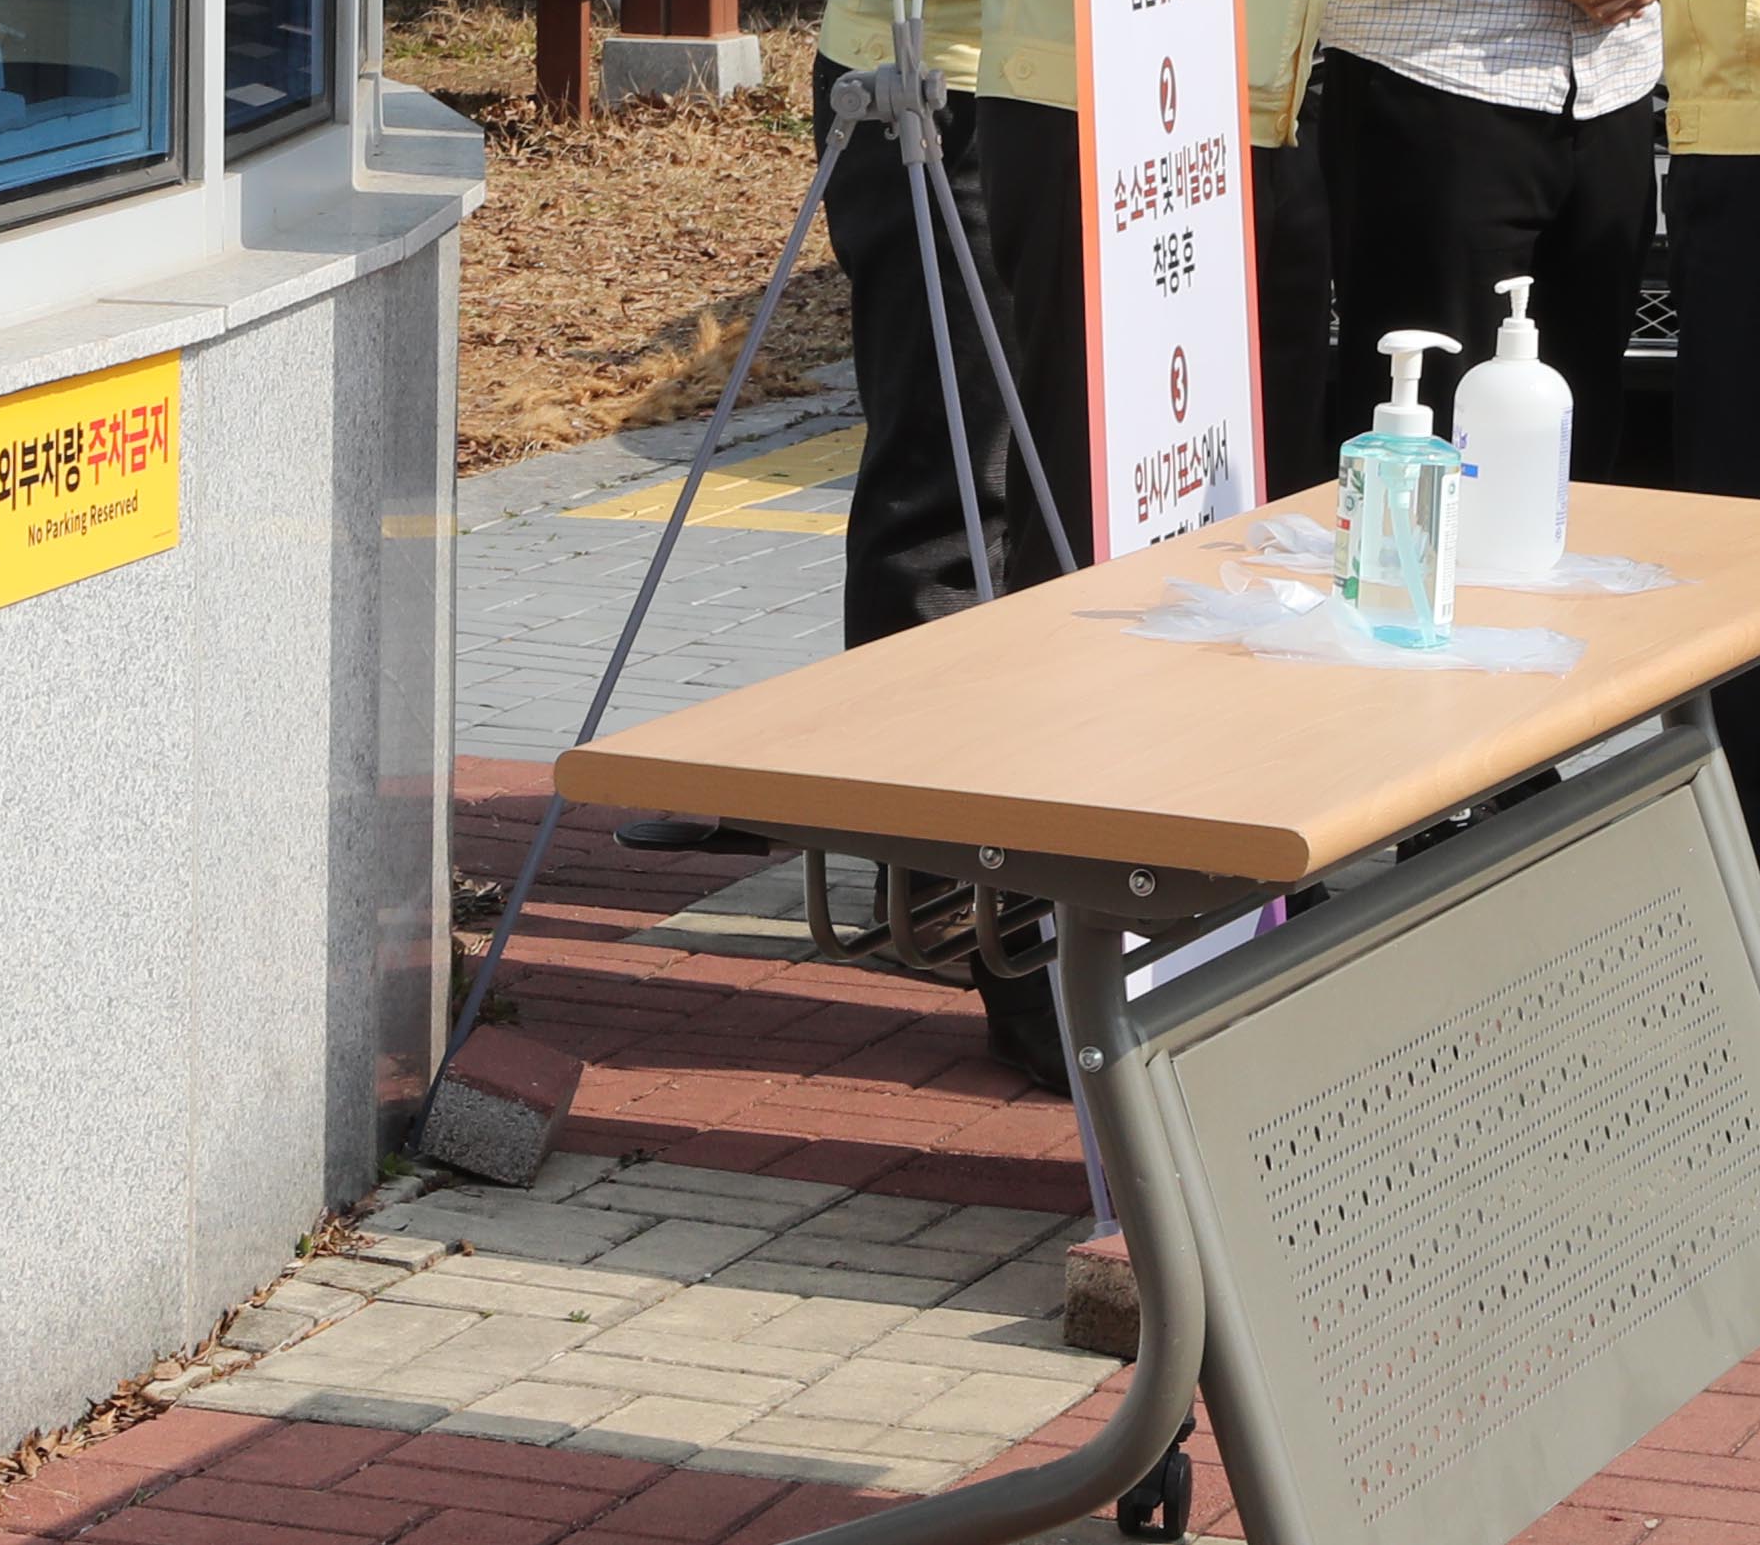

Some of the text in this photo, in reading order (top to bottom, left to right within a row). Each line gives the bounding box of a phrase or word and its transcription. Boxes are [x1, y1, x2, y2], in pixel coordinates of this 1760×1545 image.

[1175, 133, 1227, 209] 비닐장갑
[87, 396, 170, 486] 주차금지
[1134, 419, 1229, 524] 임시기표소에서
[28, 489, 139, 548] No Parking Reserved
